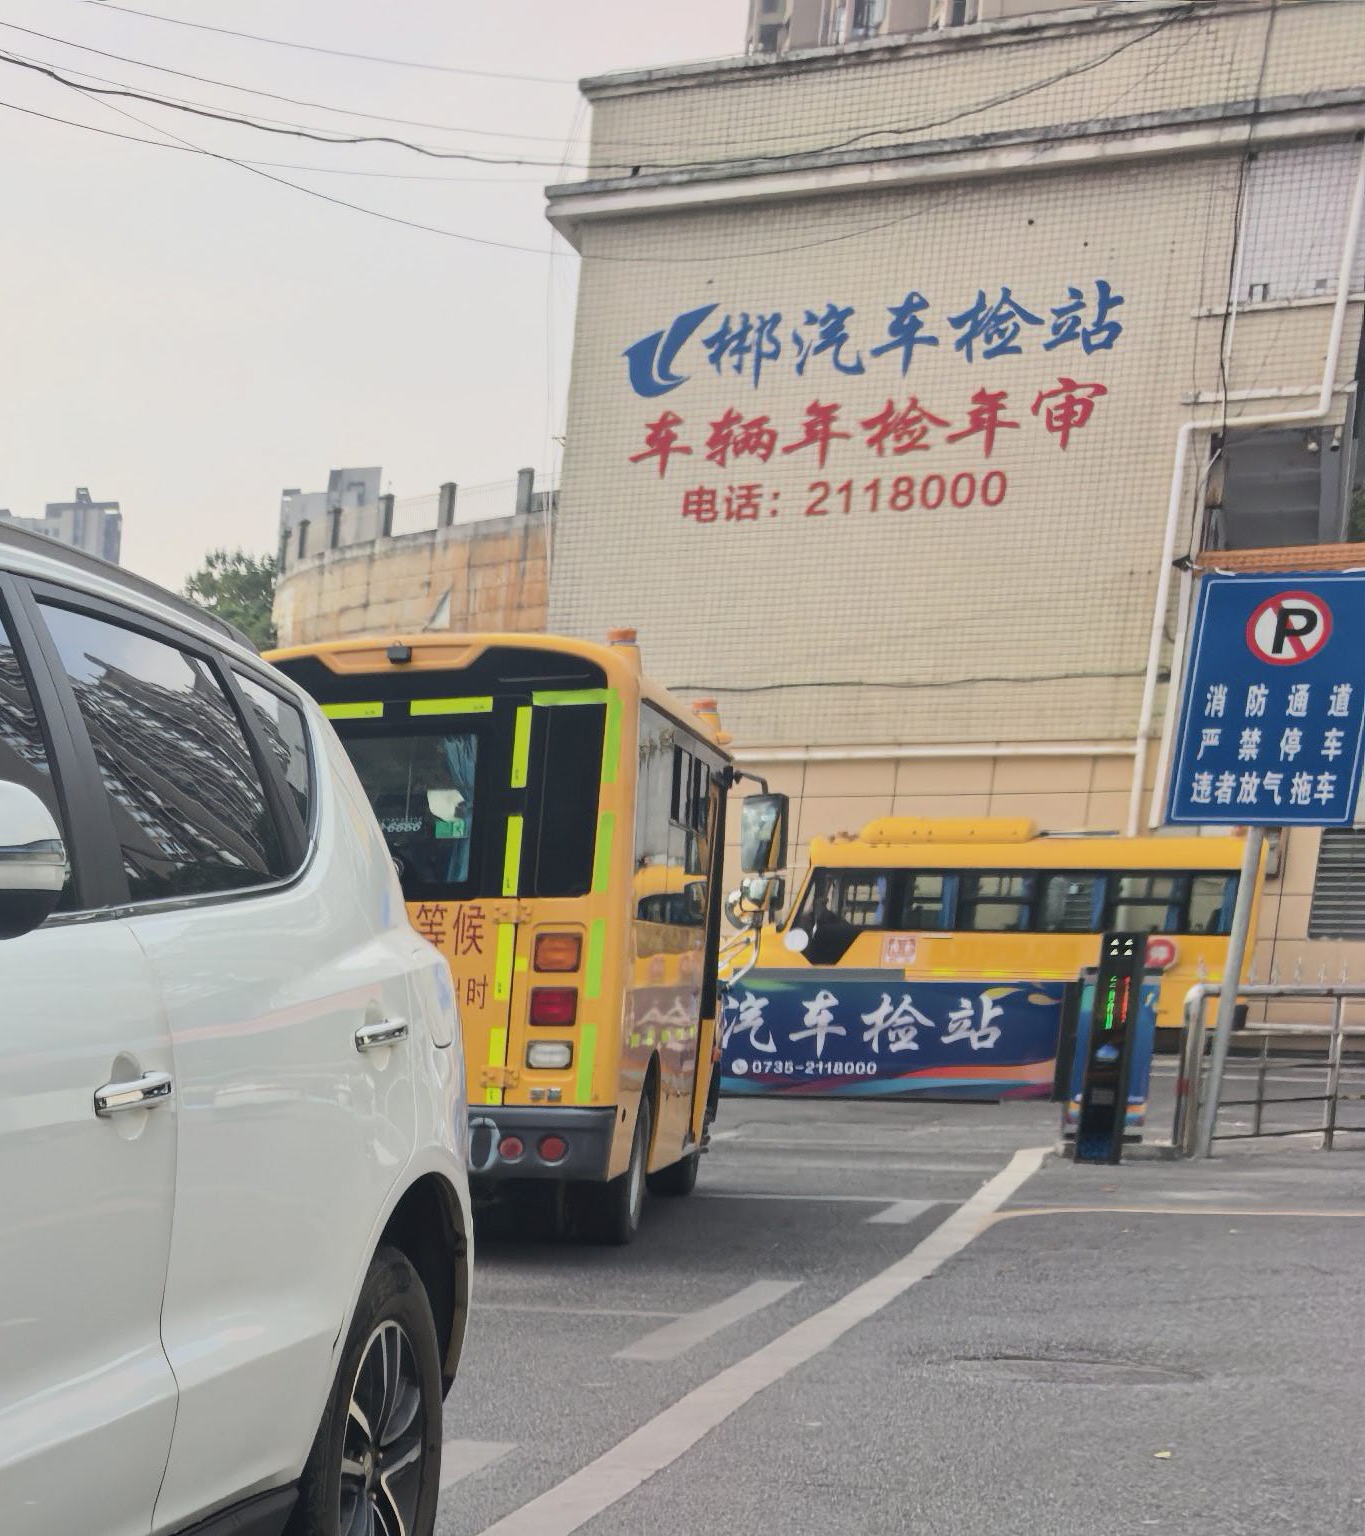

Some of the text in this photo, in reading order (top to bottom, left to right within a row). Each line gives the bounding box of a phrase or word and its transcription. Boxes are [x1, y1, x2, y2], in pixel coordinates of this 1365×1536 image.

[629, 377, 1107, 478] 车辆年检年审
[1204, 683, 1353, 717] 消防通道
[1197, 727, 1345, 762] 严禁停车
[1190, 771, 1337, 805] 违者放气拖车
[456, 975, 489, 1009] 时
[752, 1060, 877, 1075] 0735-2118000
